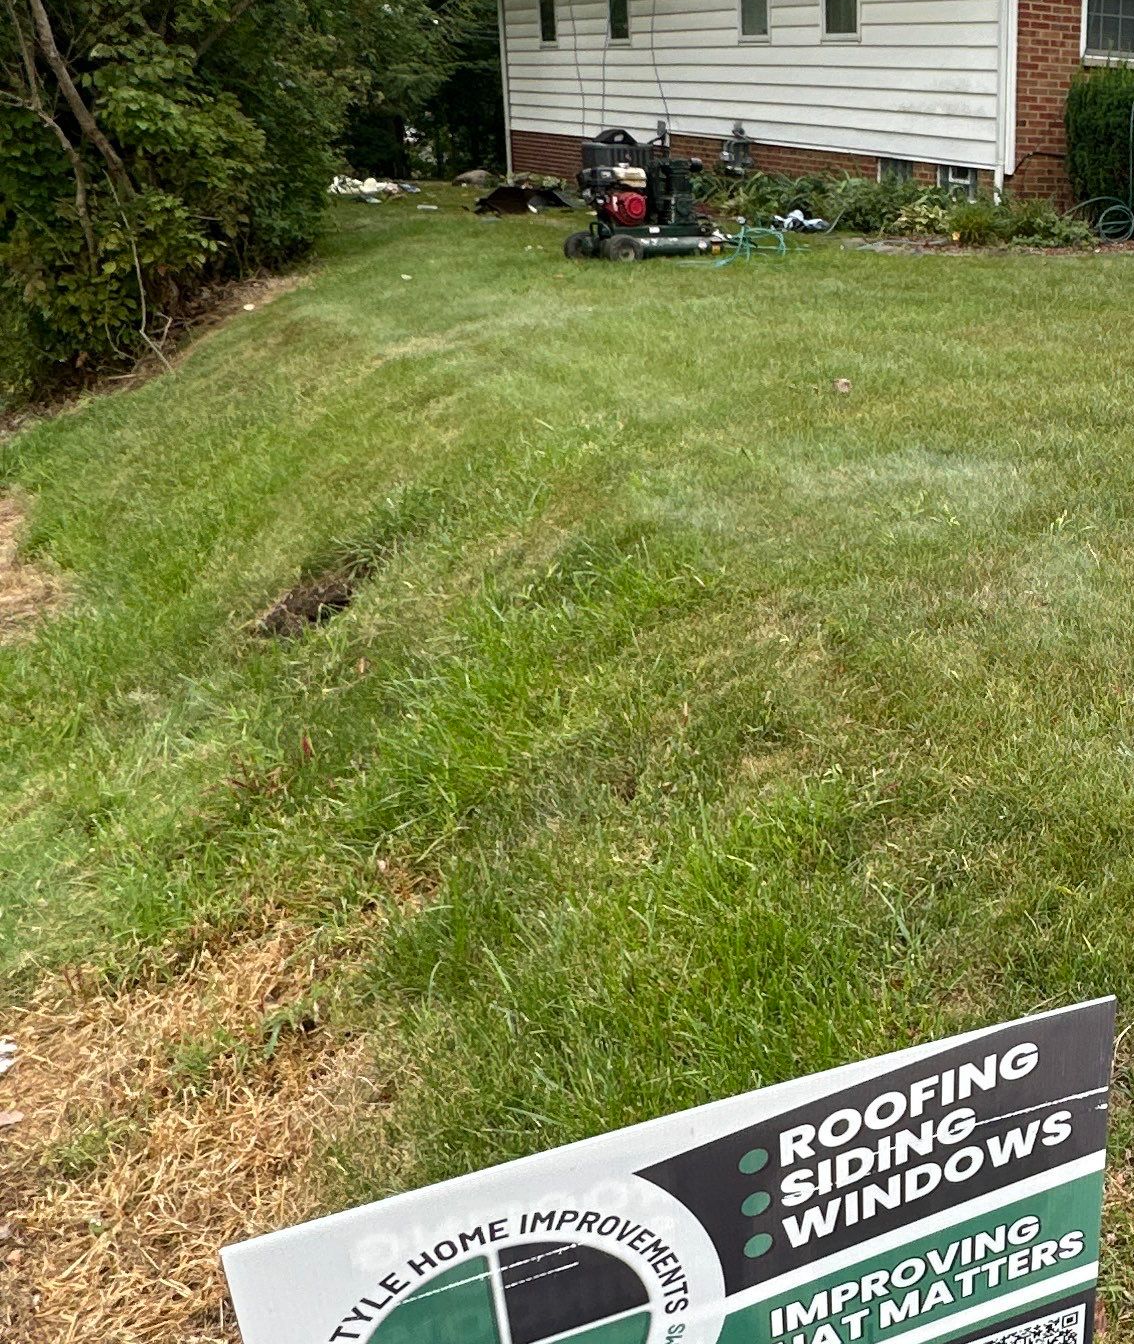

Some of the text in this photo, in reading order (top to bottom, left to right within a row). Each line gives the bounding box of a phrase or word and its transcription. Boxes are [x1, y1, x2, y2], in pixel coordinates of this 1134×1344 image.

[779, 1042, 1039, 1168] ROOFING
[779, 1108, 977, 1207] SIDING
[782, 1110, 1073, 1248] WINDOWS
[407, 1218, 509, 1276] HOME
[519, 1210, 690, 1314] IMPROVEMENTS
[770, 1215, 1041, 1338] IMPROVING
[879, 1230, 1084, 1330] MATTERS
